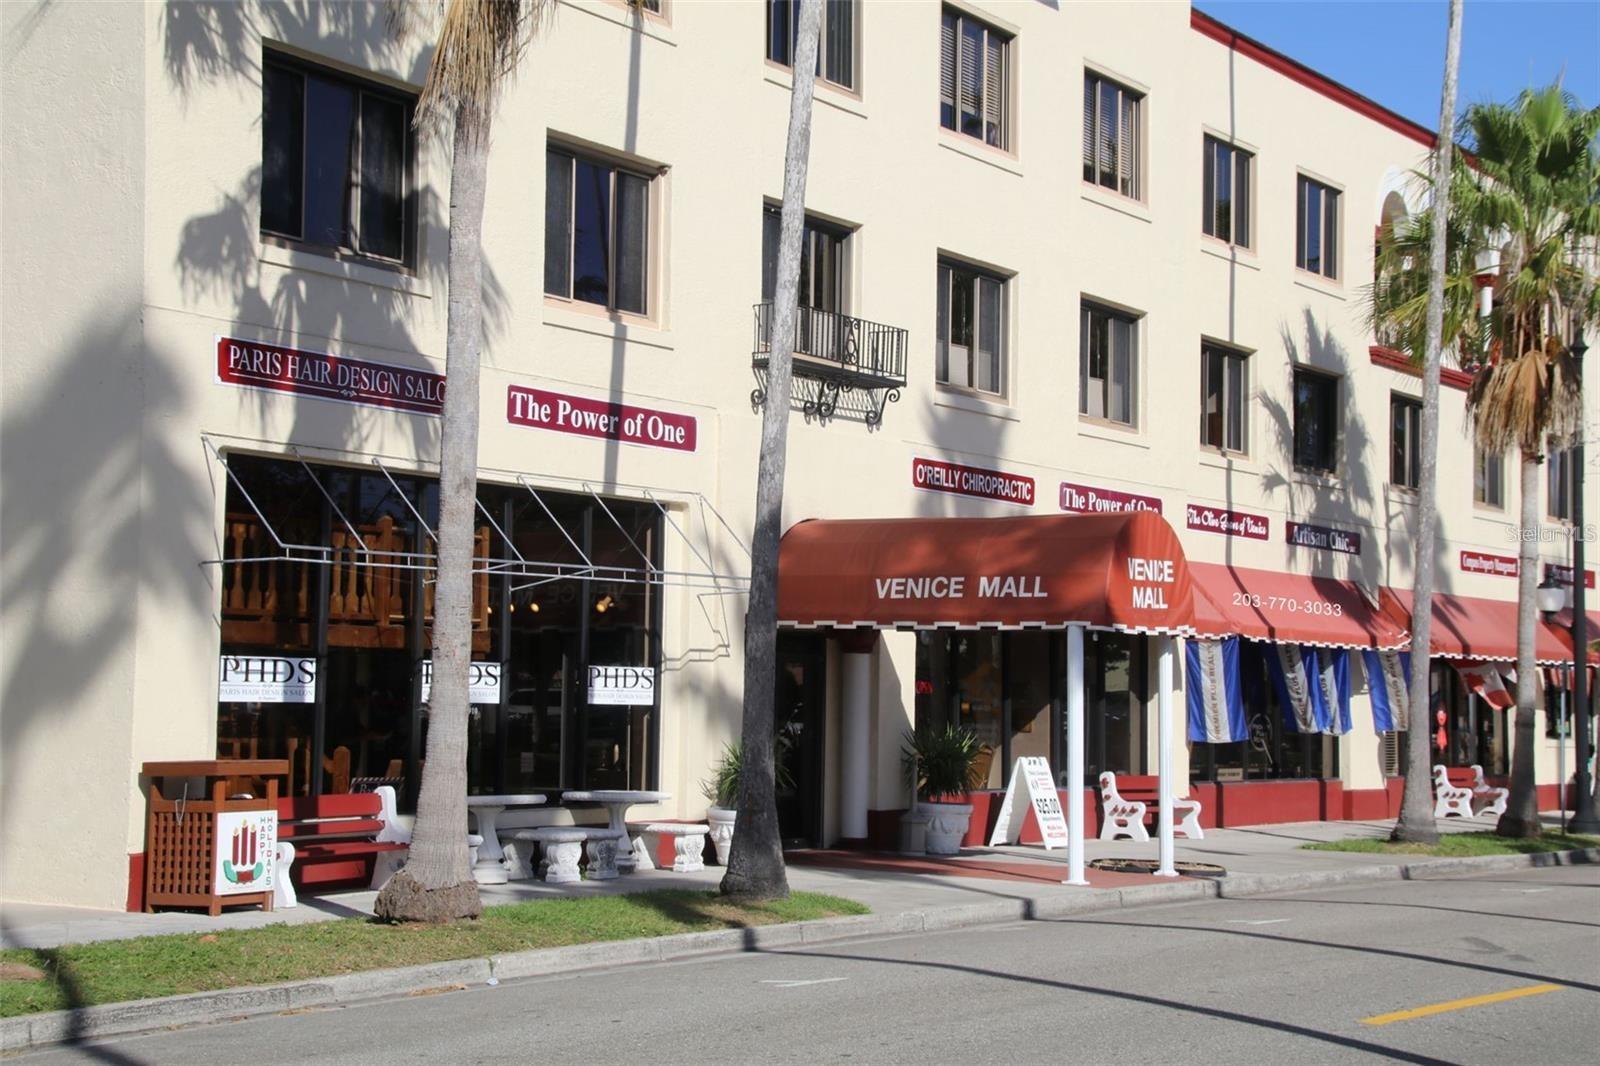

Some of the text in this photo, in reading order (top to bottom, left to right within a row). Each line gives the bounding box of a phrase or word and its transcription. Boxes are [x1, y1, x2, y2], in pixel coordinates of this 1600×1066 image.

[228, 345, 446, 403] PARIS HAIR DESIGN SALO
[510, 391, 686, 444] The Power of One
[916, 464, 1032, 501] O'REILLY CHIROPRACTIC
[1063, 487, 1086, 509] The
[1088, 491, 1122, 512] Power
[1187, 507, 1201, 525] The
[1246, 516, 1267, 535] Venice
[1292, 525, 1349, 551] Artisan Chic
[1127, 557, 1174, 583] VENICE
[875, 576, 1048, 599] VENICE MALL
[1132, 587, 1168, 609] MALL
[1232, 592, 1342, 617] 203-770-3033
[221, 658, 314, 684] PHDS
[588, 666, 653, 690] PHDS
